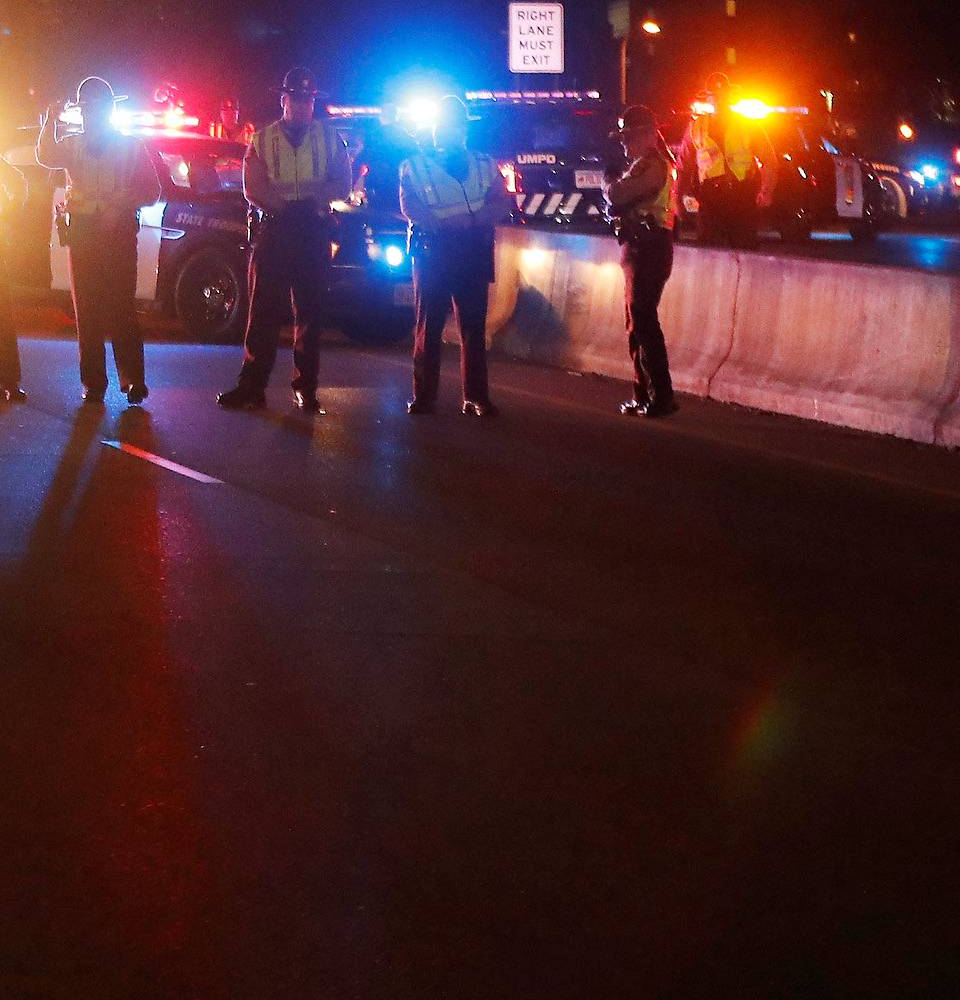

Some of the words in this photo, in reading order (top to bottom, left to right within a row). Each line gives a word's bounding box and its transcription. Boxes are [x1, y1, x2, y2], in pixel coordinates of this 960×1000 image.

[518, 11, 554, 20] RIGHT
[519, 26, 554, 36] LANE
[519, 40, 553, 50] MUST
[523, 55, 550, 65] EXIT
